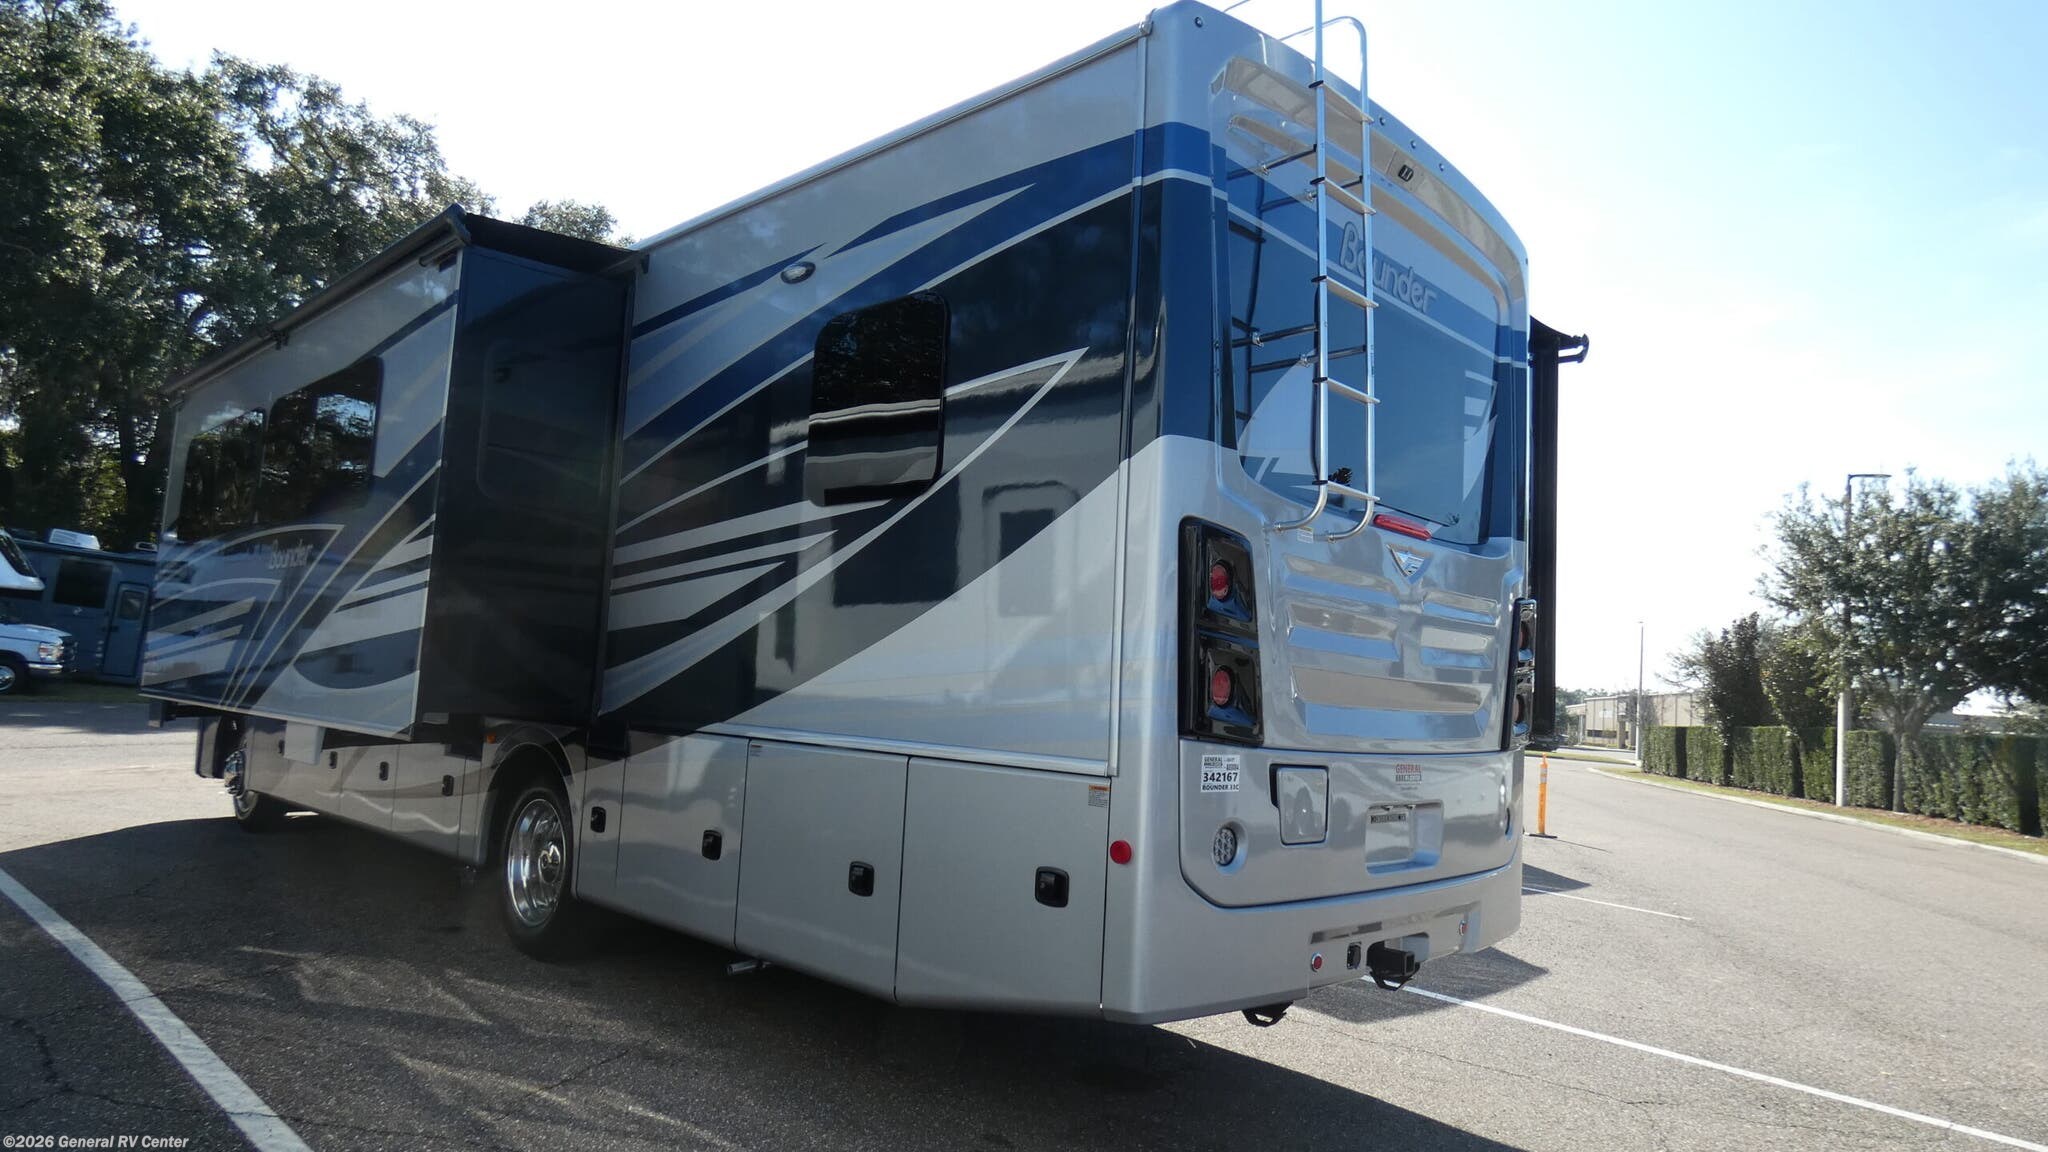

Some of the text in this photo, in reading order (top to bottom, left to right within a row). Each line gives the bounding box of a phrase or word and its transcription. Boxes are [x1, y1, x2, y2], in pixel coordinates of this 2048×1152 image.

[268, 538, 313, 569] Bounder
[1395, 764, 1422, 773] GENERAL
[1203, 772, 1238, 782] 342167
